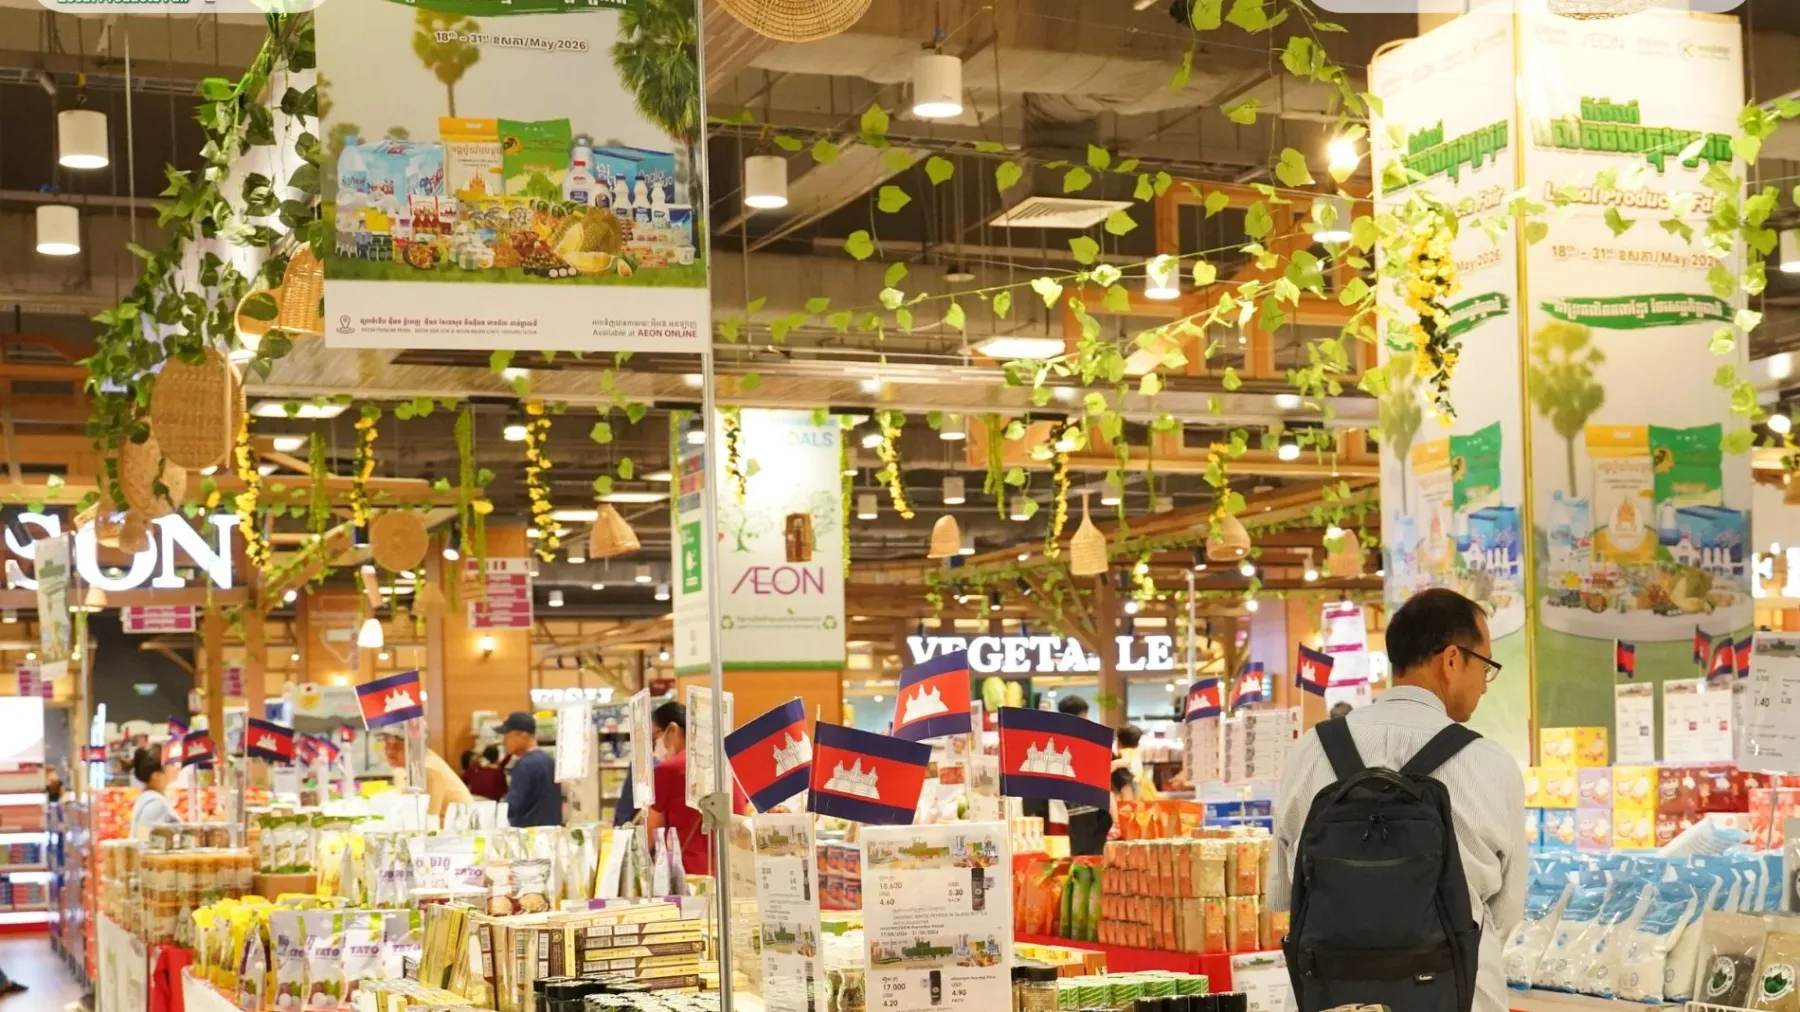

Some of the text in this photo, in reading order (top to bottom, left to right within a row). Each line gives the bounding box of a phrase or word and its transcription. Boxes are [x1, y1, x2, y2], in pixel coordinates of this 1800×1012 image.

[434, 30, 458, 44] 18th
[470, 34, 489, 45] 31st
[557, 40, 587, 51] 2026
[1544, 181, 1600, 204] Lal
[1603, 185, 1674, 210] Produc
[592, 329, 626, 337] Available
[637, 329, 663, 338] AEON
[664, 329, 698, 338] ONLINE
[906, 635, 1172, 673] VGETALE
[315, 947, 340, 957] TATO
[350, 945, 380, 955] TATO
[883, 983, 906, 991] 17.000
[951, 989, 967, 997] 4.90
[883, 999, 898, 1008] 4.20
